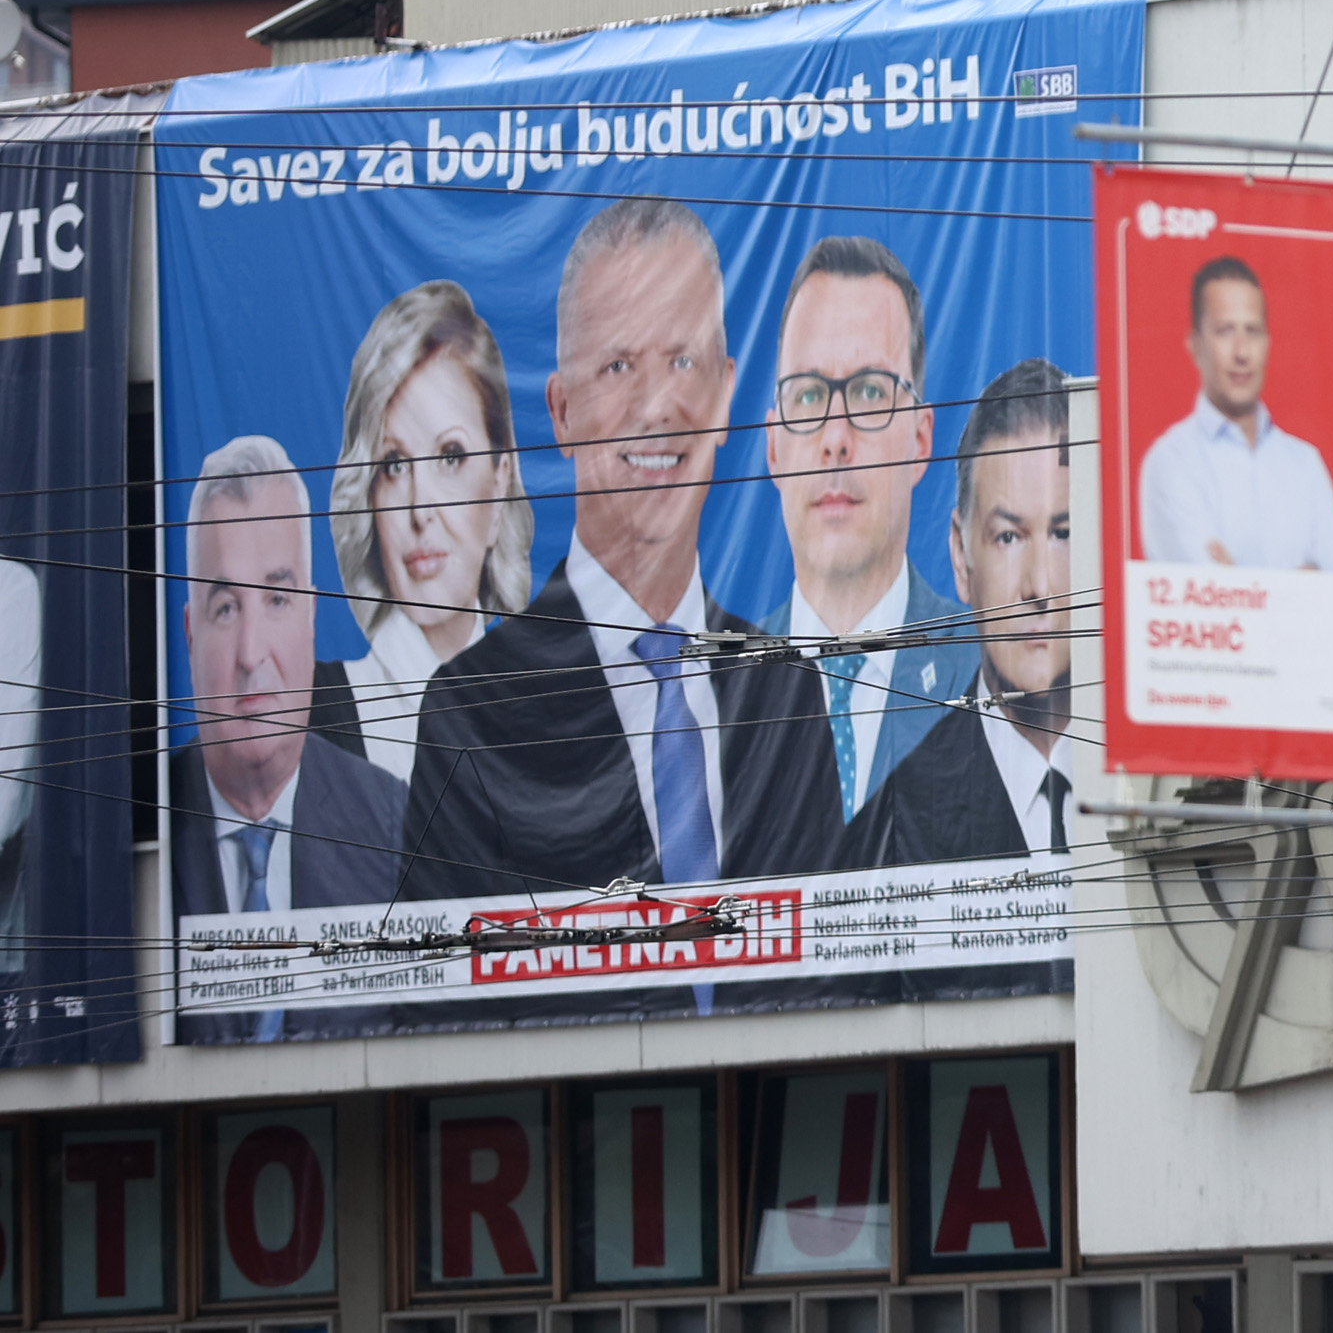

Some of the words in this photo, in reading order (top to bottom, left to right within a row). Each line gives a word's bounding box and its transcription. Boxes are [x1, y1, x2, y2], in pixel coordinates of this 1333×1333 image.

[1041, 72, 1074, 98] SBB
[198, 145, 347, 210] Savez
[356, 143, 414, 189] za
[426, 115, 564, 193] bolju
[577, 76, 873, 166] budućnost
[884, 56, 982, 128] BiH
[1147, 578, 1177, 606] 12.
[1183, 579, 1270, 609] Ademir
[868, 914, 900, 930] liste
[903, 916, 917, 928] za
[952, 905, 982, 921] liste
[986, 904, 1001, 917] za
[320, 922, 374, 942] SANELA
[952, 930, 1014, 950] Kantona
[815, 941, 888, 961] Parlament
[894, 938, 916, 955] BiH
[191, 956, 239, 974] Nosilac
[190, 978, 262, 998] Parlament
[264, 976, 296, 995] FBiH
[323, 978, 338, 991] za
[341, 970, 409, 990] Parlament
[413, 967, 444, 986] FBiH
